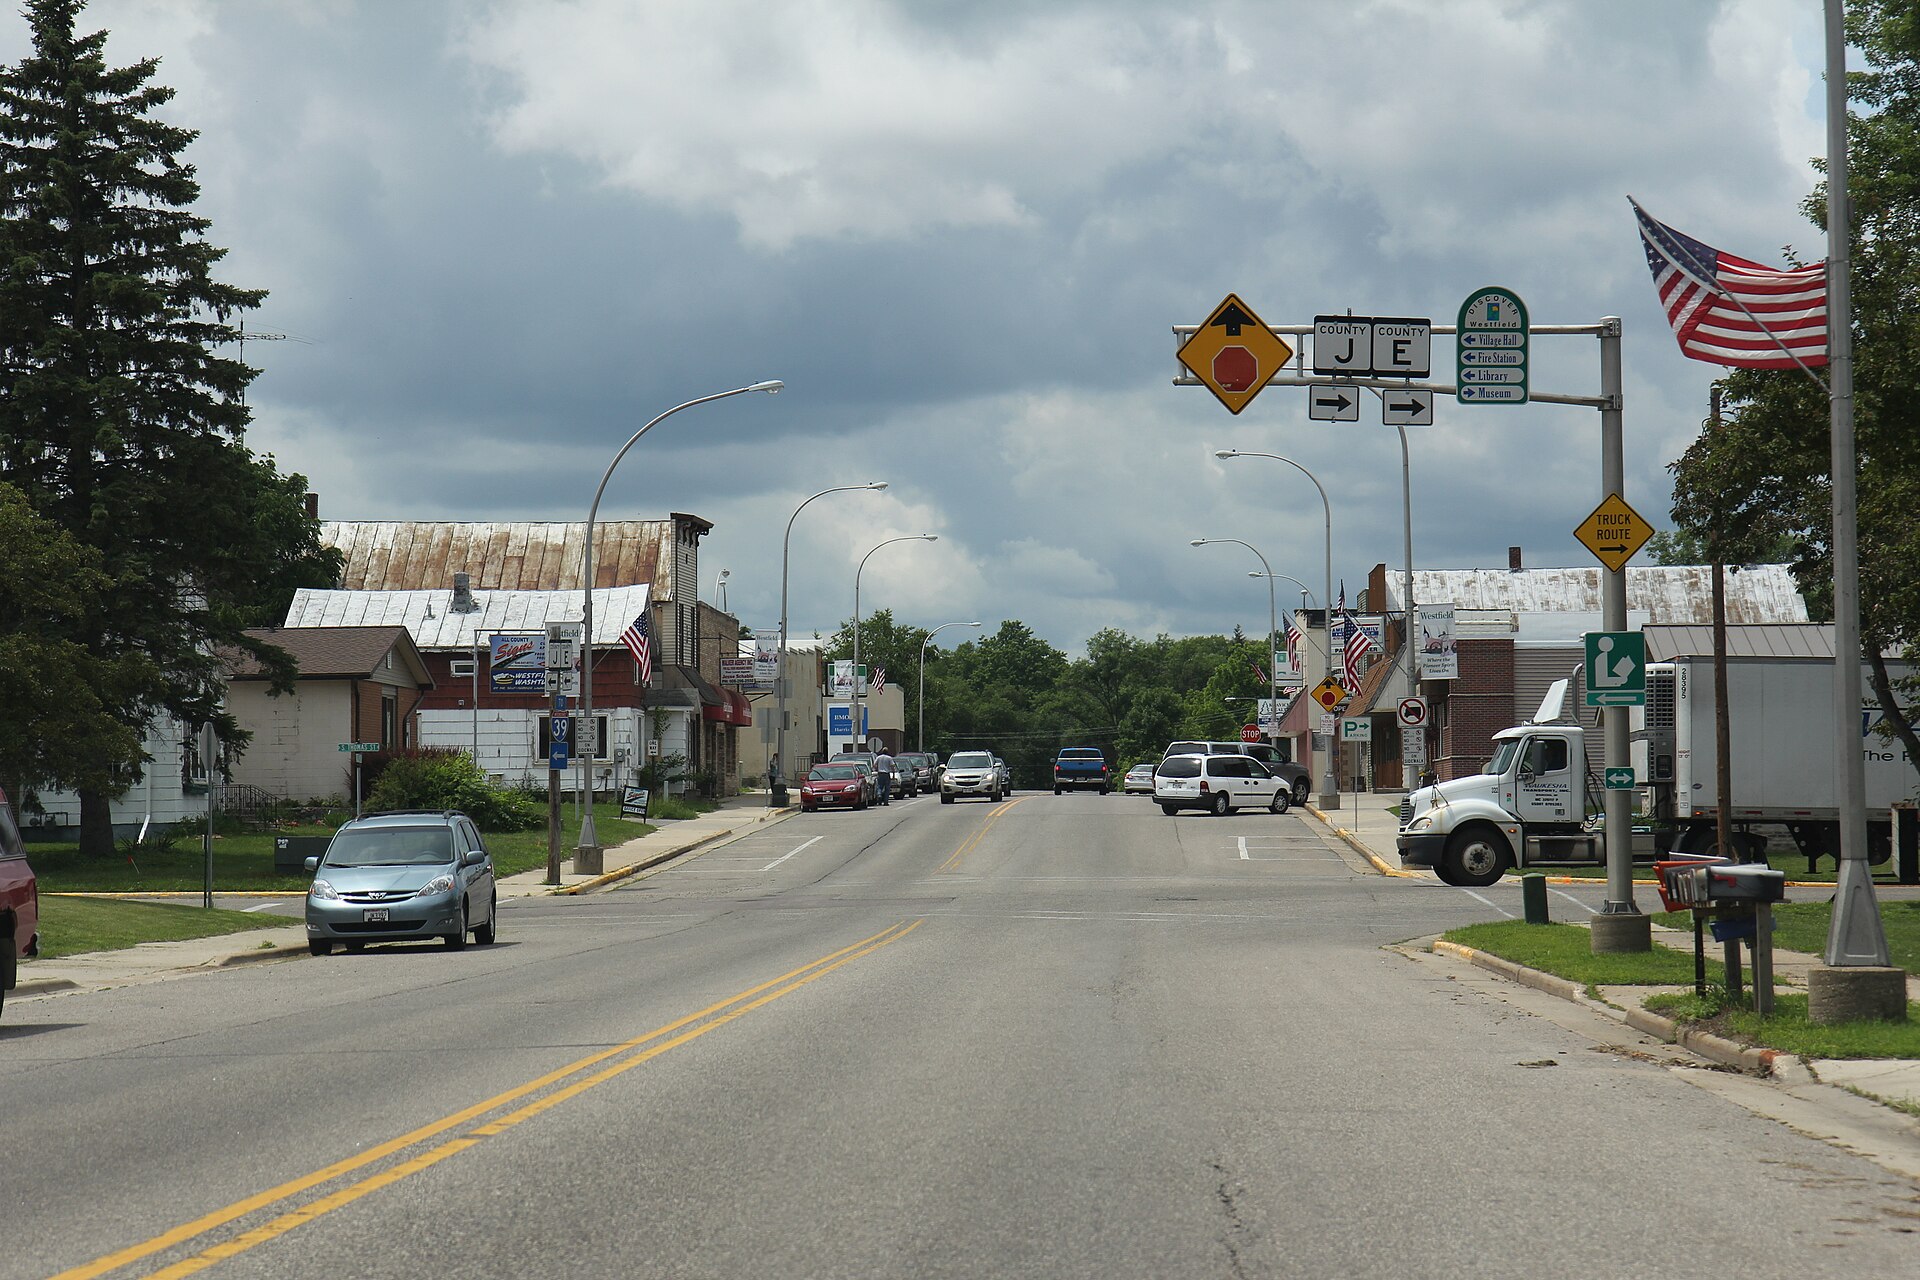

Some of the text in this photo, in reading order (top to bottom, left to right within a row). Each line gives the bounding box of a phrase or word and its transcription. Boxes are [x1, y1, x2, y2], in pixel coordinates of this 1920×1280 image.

[1469, 295, 1518, 315] DISCOVER
[1320, 325, 1366, 335] COUNTY
[1378, 327, 1424, 336] COUNTY
[1479, 334, 1517, 347] Village Hall
[1334, 338, 1354, 364] J
[1393, 339, 1412, 365] E
[1478, 352, 1517, 363] Fire Station
[1478, 370, 1508, 382] Library
[1478, 387, 1511, 398] Museum
[1596, 514, 1631, 525] TRUCK
[1597, 528, 1631, 540] ROUTE
[1420, 611, 1454, 620] Westfield
[495, 641, 535, 660] Signs
[553, 650, 558, 665] J
[564, 650, 569, 664] E
[553, 719, 567, 737] 39
[1242, 730, 1260, 738] STOP
[1863, 750, 1894, 761] The
